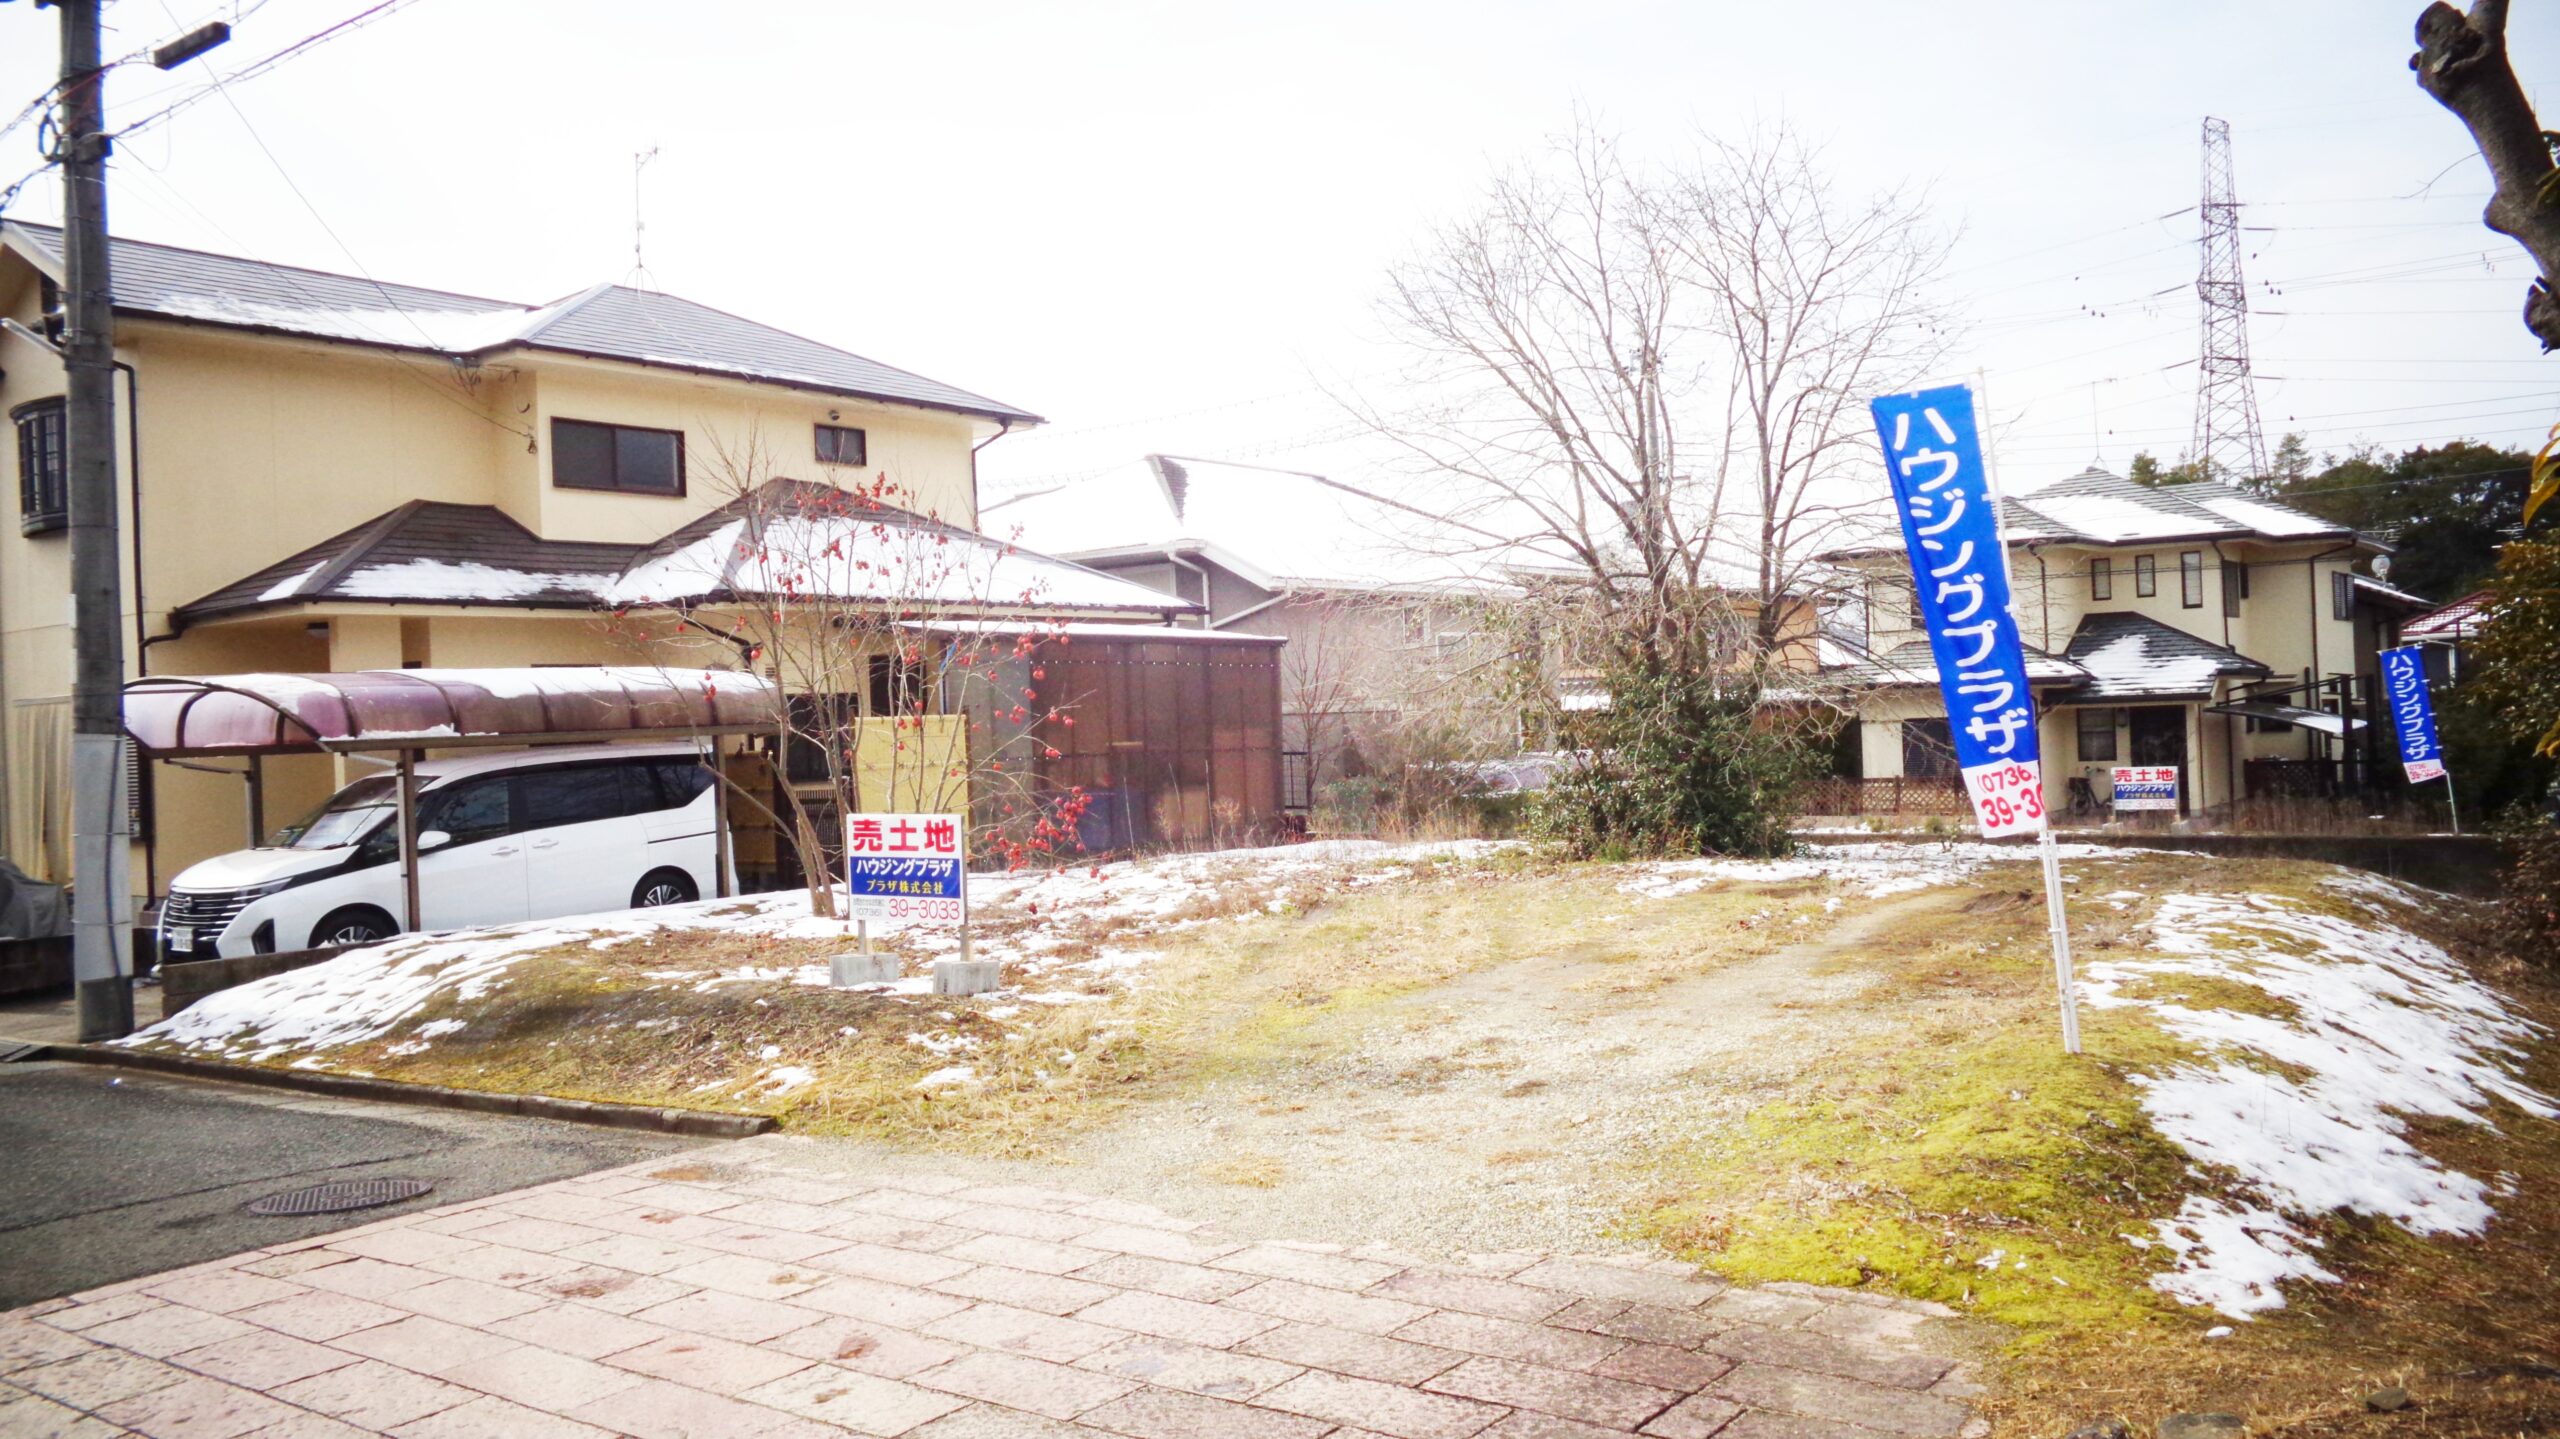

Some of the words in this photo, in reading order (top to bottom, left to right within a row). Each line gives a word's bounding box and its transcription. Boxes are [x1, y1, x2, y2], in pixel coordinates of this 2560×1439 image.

[1893, 407, 2029, 754] ハウジングプラザ
[2389, 654, 2430, 760] ハウジングプラザ
[2115, 768, 2174, 782] 売土地
[853, 819, 955, 852] 売土地
[856, 858, 954, 877] ハウジングプラザ
[866, 879, 943, 895] プラザ株式会社
[888, 898, 960, 920] 39-3033
